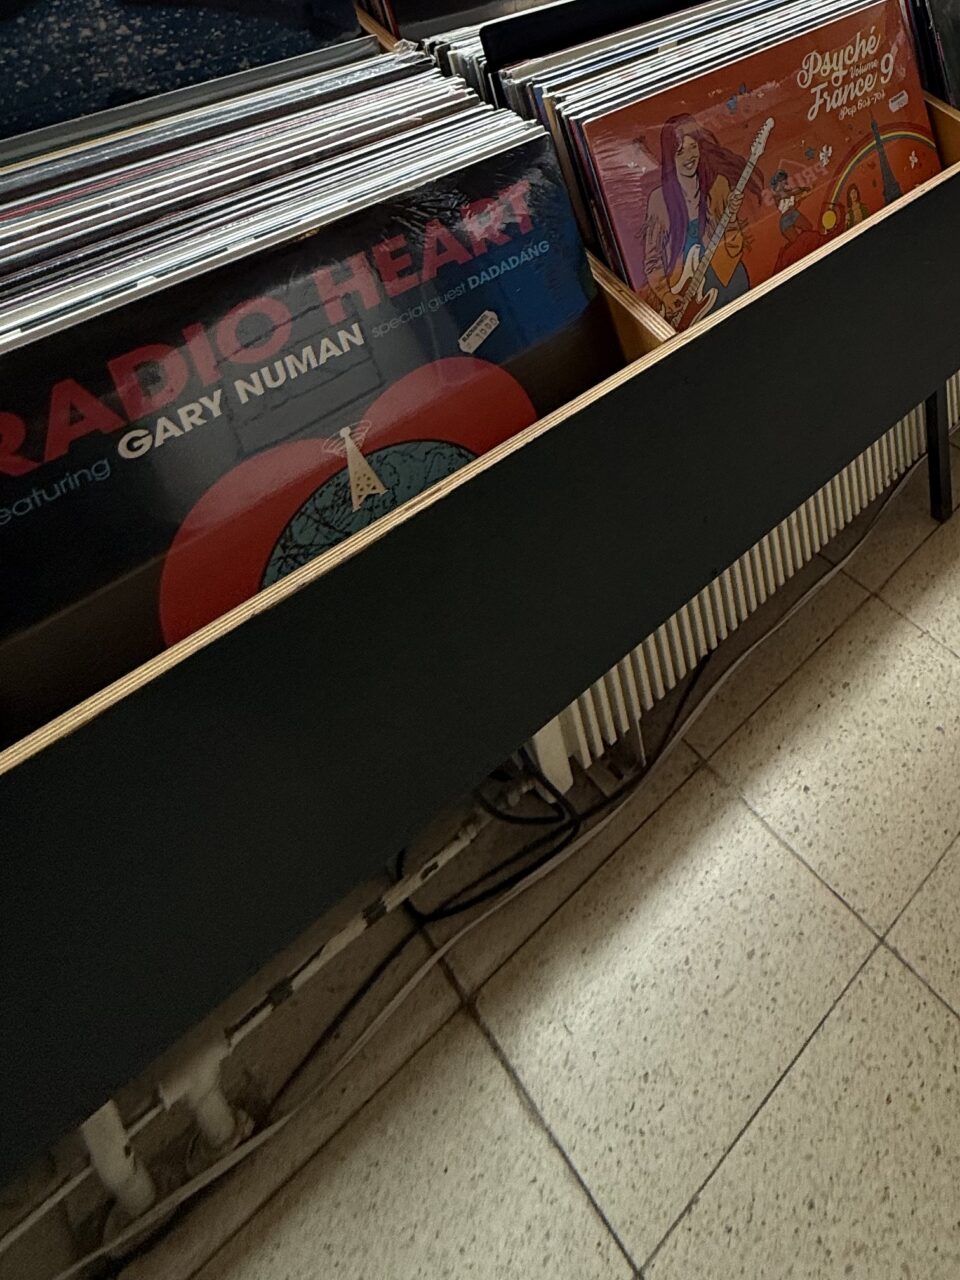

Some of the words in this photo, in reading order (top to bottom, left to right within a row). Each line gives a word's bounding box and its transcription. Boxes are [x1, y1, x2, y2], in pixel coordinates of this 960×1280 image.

[797, 25, 881, 89] Psyché
[850, 59, 879, 79] Volume
[880, 52, 894, 84] 9
[807, 71, 878, 121] France
[839, 107, 857, 121] Pop
[371, 302, 425, 338] special
[427, 281, 467, 312] guest
[467, 239, 551, 290] DADADANG
[0, 295, 293, 477] RADIO
[314, 178, 536, 320] HEART
[0, 458, 112, 523] eaturing
[116, 388, 224, 460] GARY
[233, 322, 366, 406] NUMAN
